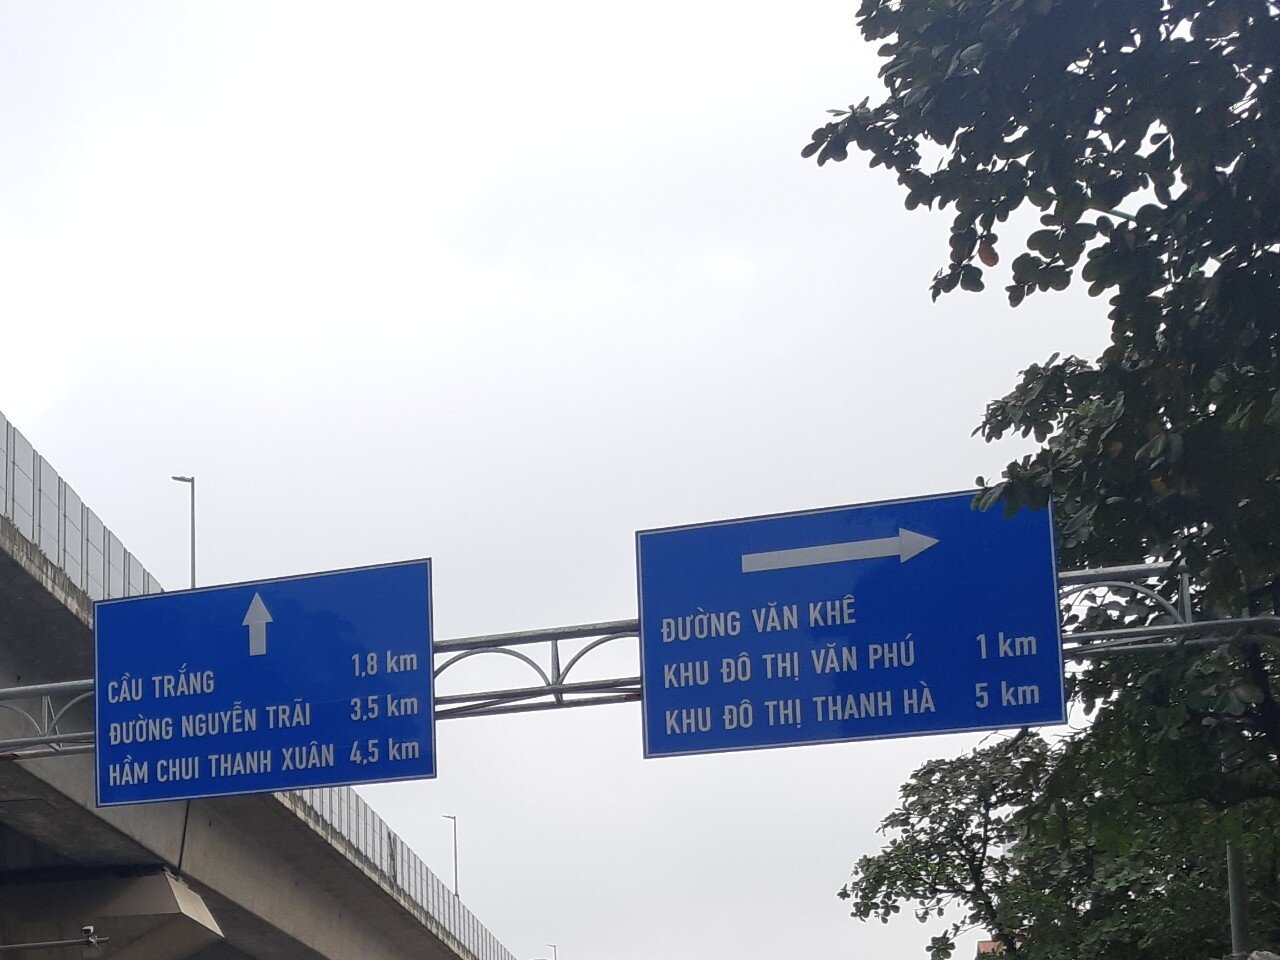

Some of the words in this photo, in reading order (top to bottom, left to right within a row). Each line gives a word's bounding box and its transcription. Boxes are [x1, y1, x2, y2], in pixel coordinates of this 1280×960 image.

[661, 607, 740, 643] ĐƯỜNG
[752, 602, 798, 633] VĂN
[809, 594, 856, 627] KHÊ
[108, 673, 143, 703] CẦU
[152, 663, 215, 698] TRẮNG
[351, 653, 377, 677] 1,8
[387, 651, 417, 673] km
[663, 660, 709, 689] KHU
[720, 652, 750, 683] ĐÔ
[762, 652, 799, 681] THỊ
[811, 643, 857, 676] VĂN
[868, 633, 915, 669] PHÚ
[975, 634, 987, 659] 1
[999, 632, 1036, 658] km
[109, 715, 172, 745] ĐƯỜNG
[182, 701, 256, 737] NGUYỄN
[266, 699, 310, 729] TRÃI
[350, 697, 379, 722] 3,5
[387, 694, 418, 717] km
[665, 706, 711, 735] KHU
[723, 701, 753, 730] ĐÔ
[764, 700, 801, 729] THỊ
[813, 691, 892, 722] THANH
[903, 681, 935, 715] HÀ
[975, 682, 989, 709] 5
[1001, 681, 1039, 706] km
[109, 755, 148, 786] HẦM
[157, 757, 199, 782] CHUI
[208, 750, 271, 778] THANH
[282, 741, 334, 771] XUÂN
[349, 740, 379, 765] 4,5
[388, 738, 419, 760] km
